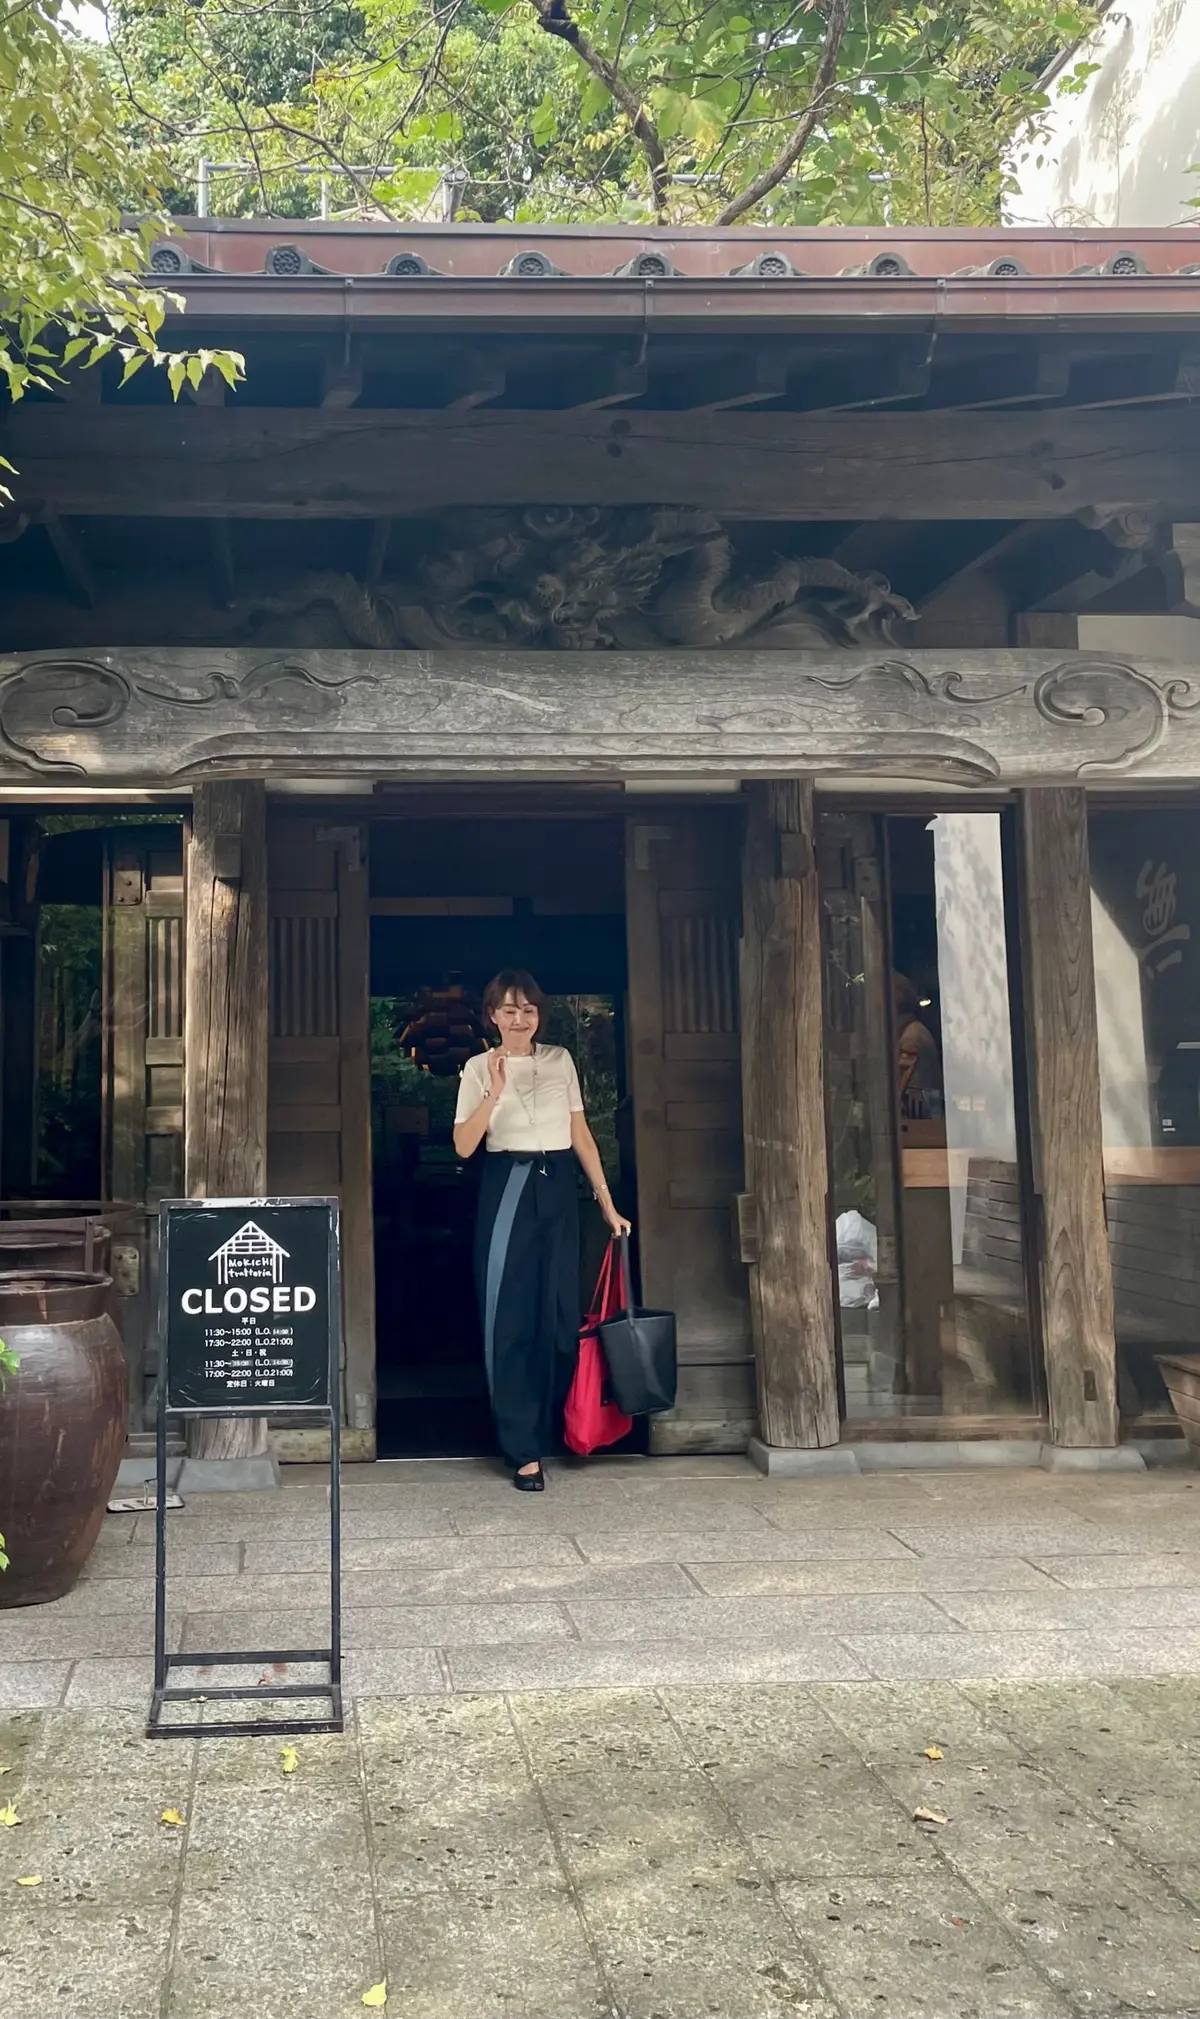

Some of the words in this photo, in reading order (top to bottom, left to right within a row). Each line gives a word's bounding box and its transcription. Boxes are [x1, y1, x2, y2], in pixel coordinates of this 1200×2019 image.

[228, 1268, 272, 1278] trattoria
[181, 1286, 317, 1315] CLOSED
[241, 1316, 257, 1326] 平日
